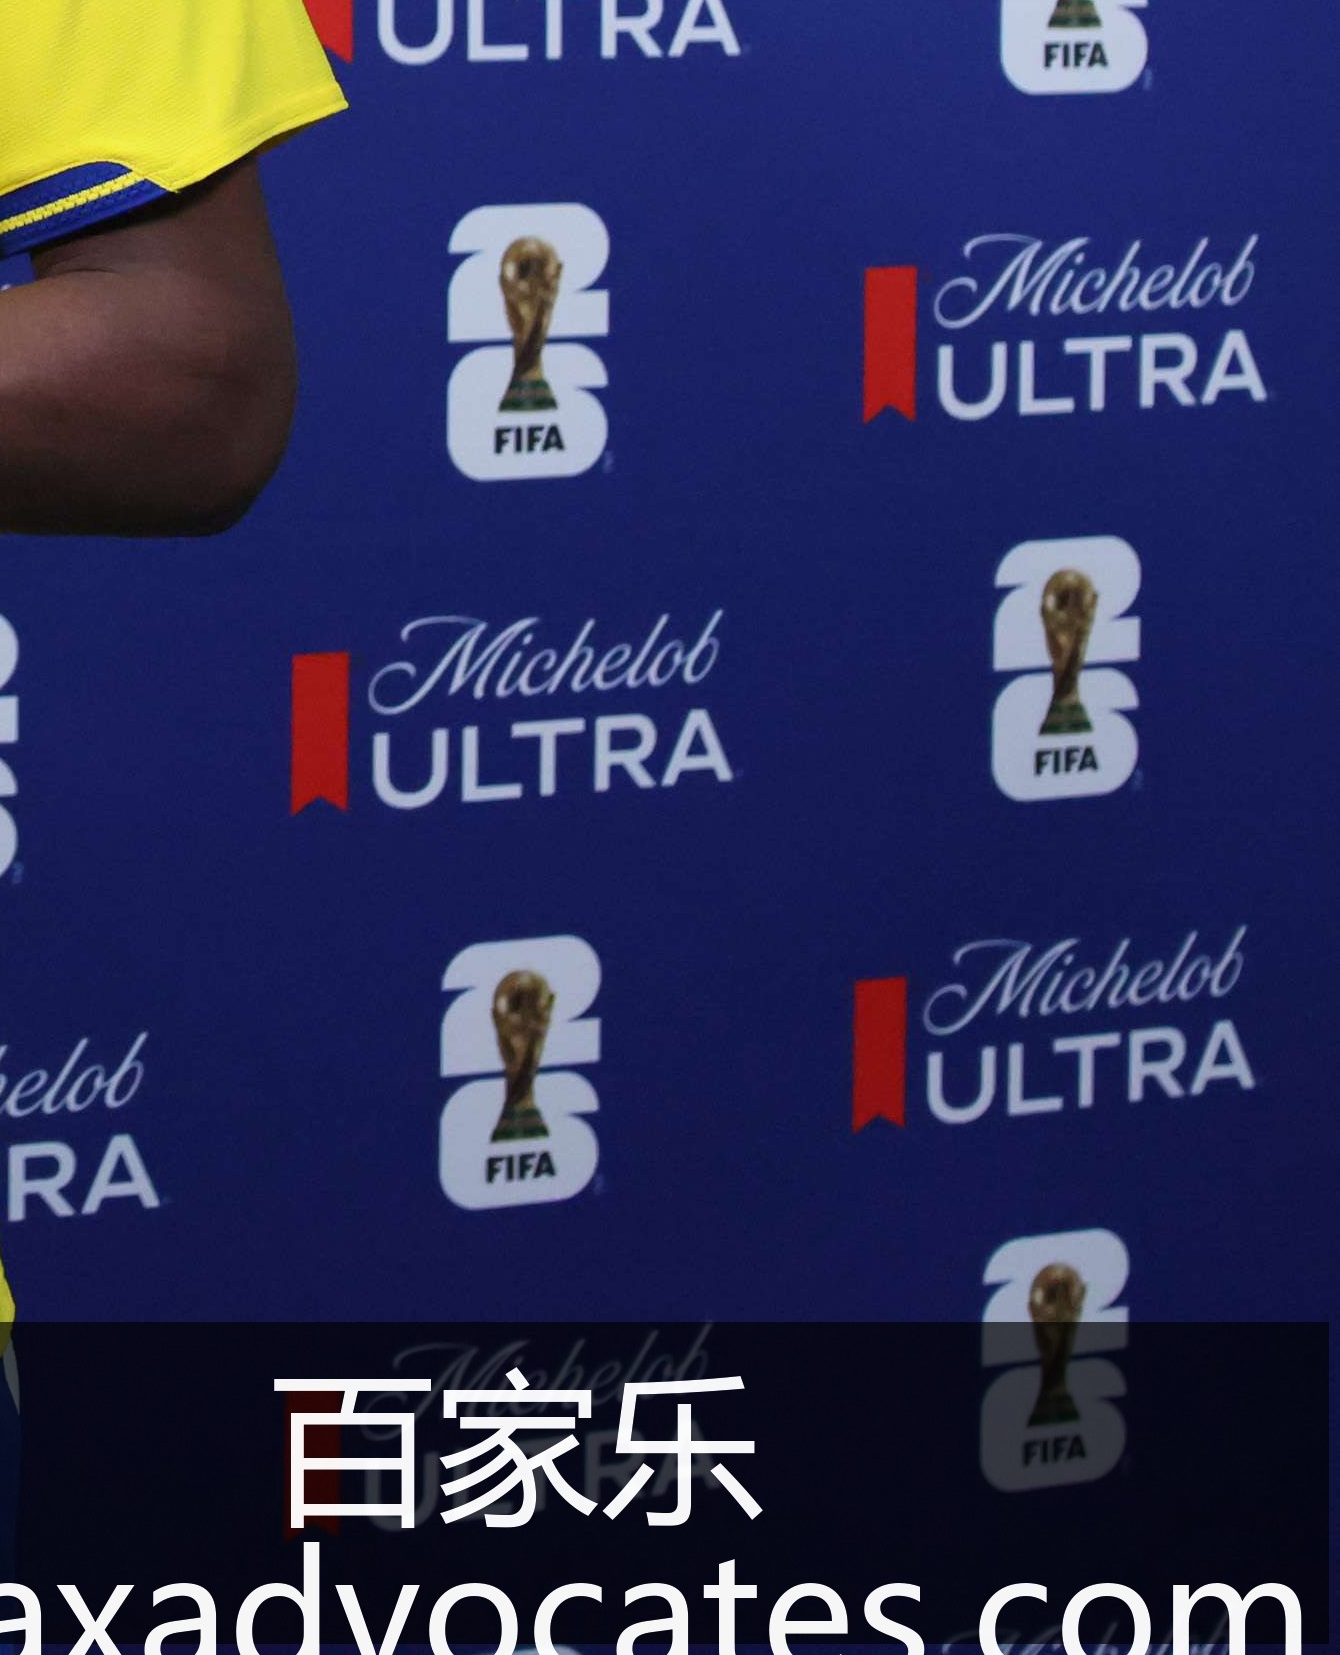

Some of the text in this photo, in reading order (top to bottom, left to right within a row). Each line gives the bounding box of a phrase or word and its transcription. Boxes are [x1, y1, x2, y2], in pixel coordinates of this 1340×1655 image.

[1044, 43, 1108, 68] FIFA
[934, 234, 1258, 328] Michelob
[938, 330, 1267, 420] ULTRA
[495, 425, 564, 454] FIFA
[369, 609, 723, 714] Michelob
[373, 709, 733, 809] ULTRA
[1035, 747, 1098, 775] FIFA
[924, 926, 1246, 1035] Michelob
[927, 1020, 1255, 1123] ULTRA
[486, 1151, 555, 1183] FIFA
[1023, 1435, 1086, 1466] FIFA
